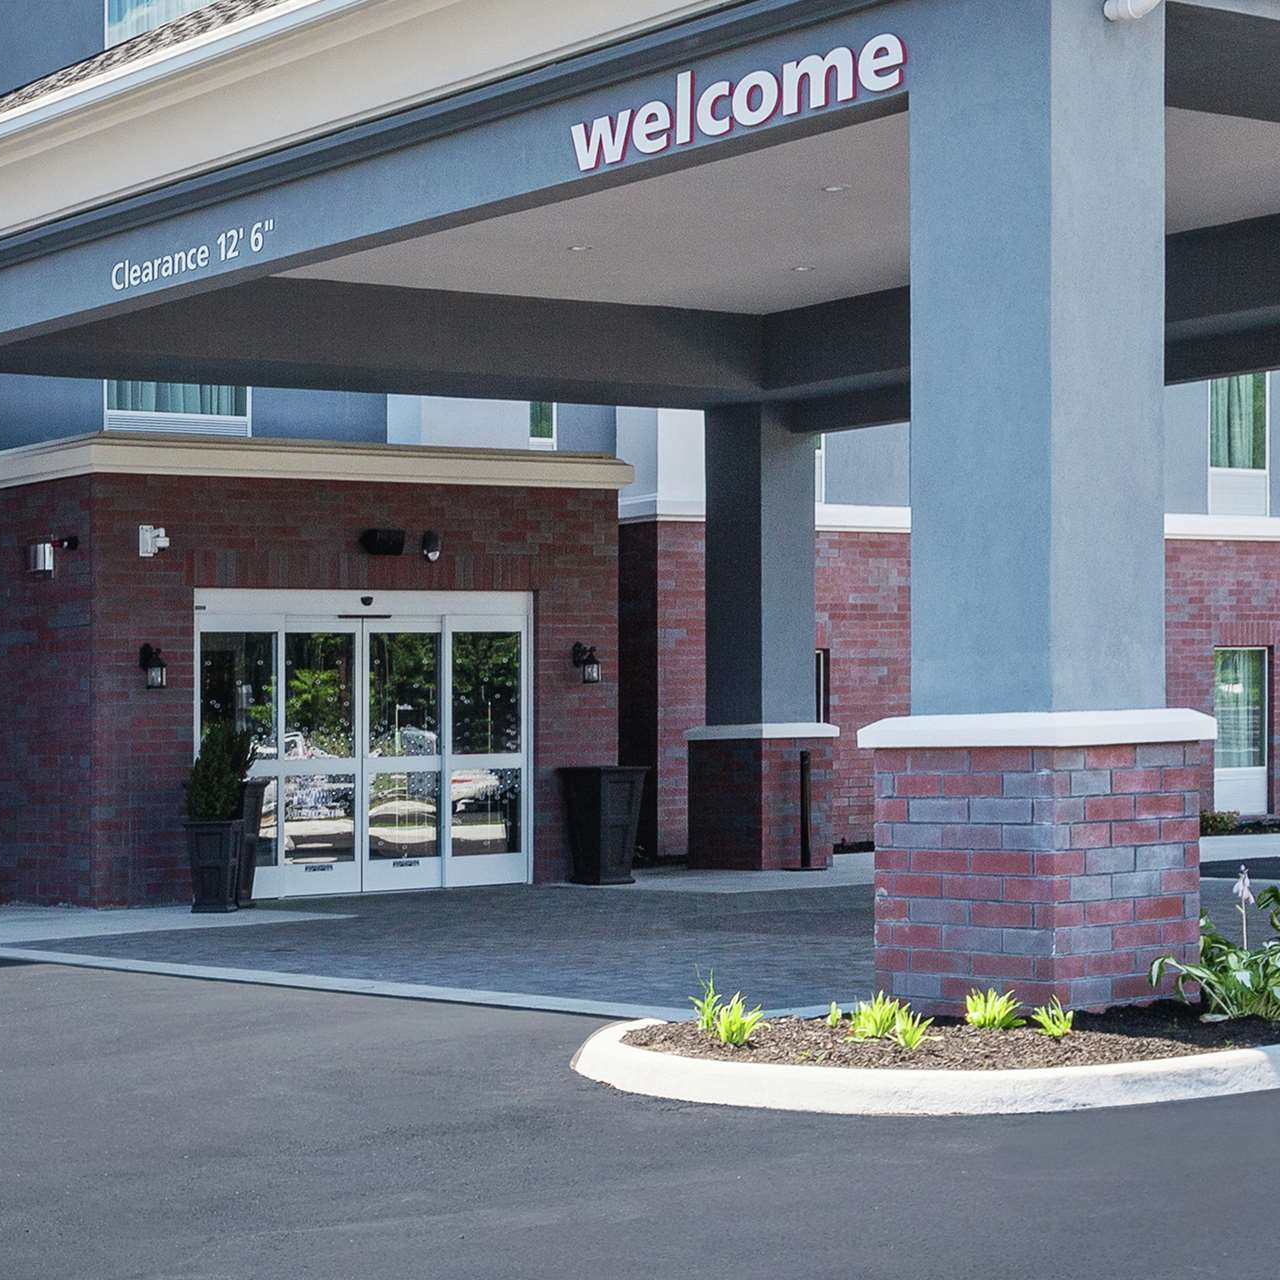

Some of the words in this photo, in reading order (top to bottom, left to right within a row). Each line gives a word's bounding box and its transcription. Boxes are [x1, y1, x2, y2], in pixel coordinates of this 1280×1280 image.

[570, 33, 907, 171] welcome
[110, 243, 209, 291] Clearance
[216, 227, 244, 262] 12'
